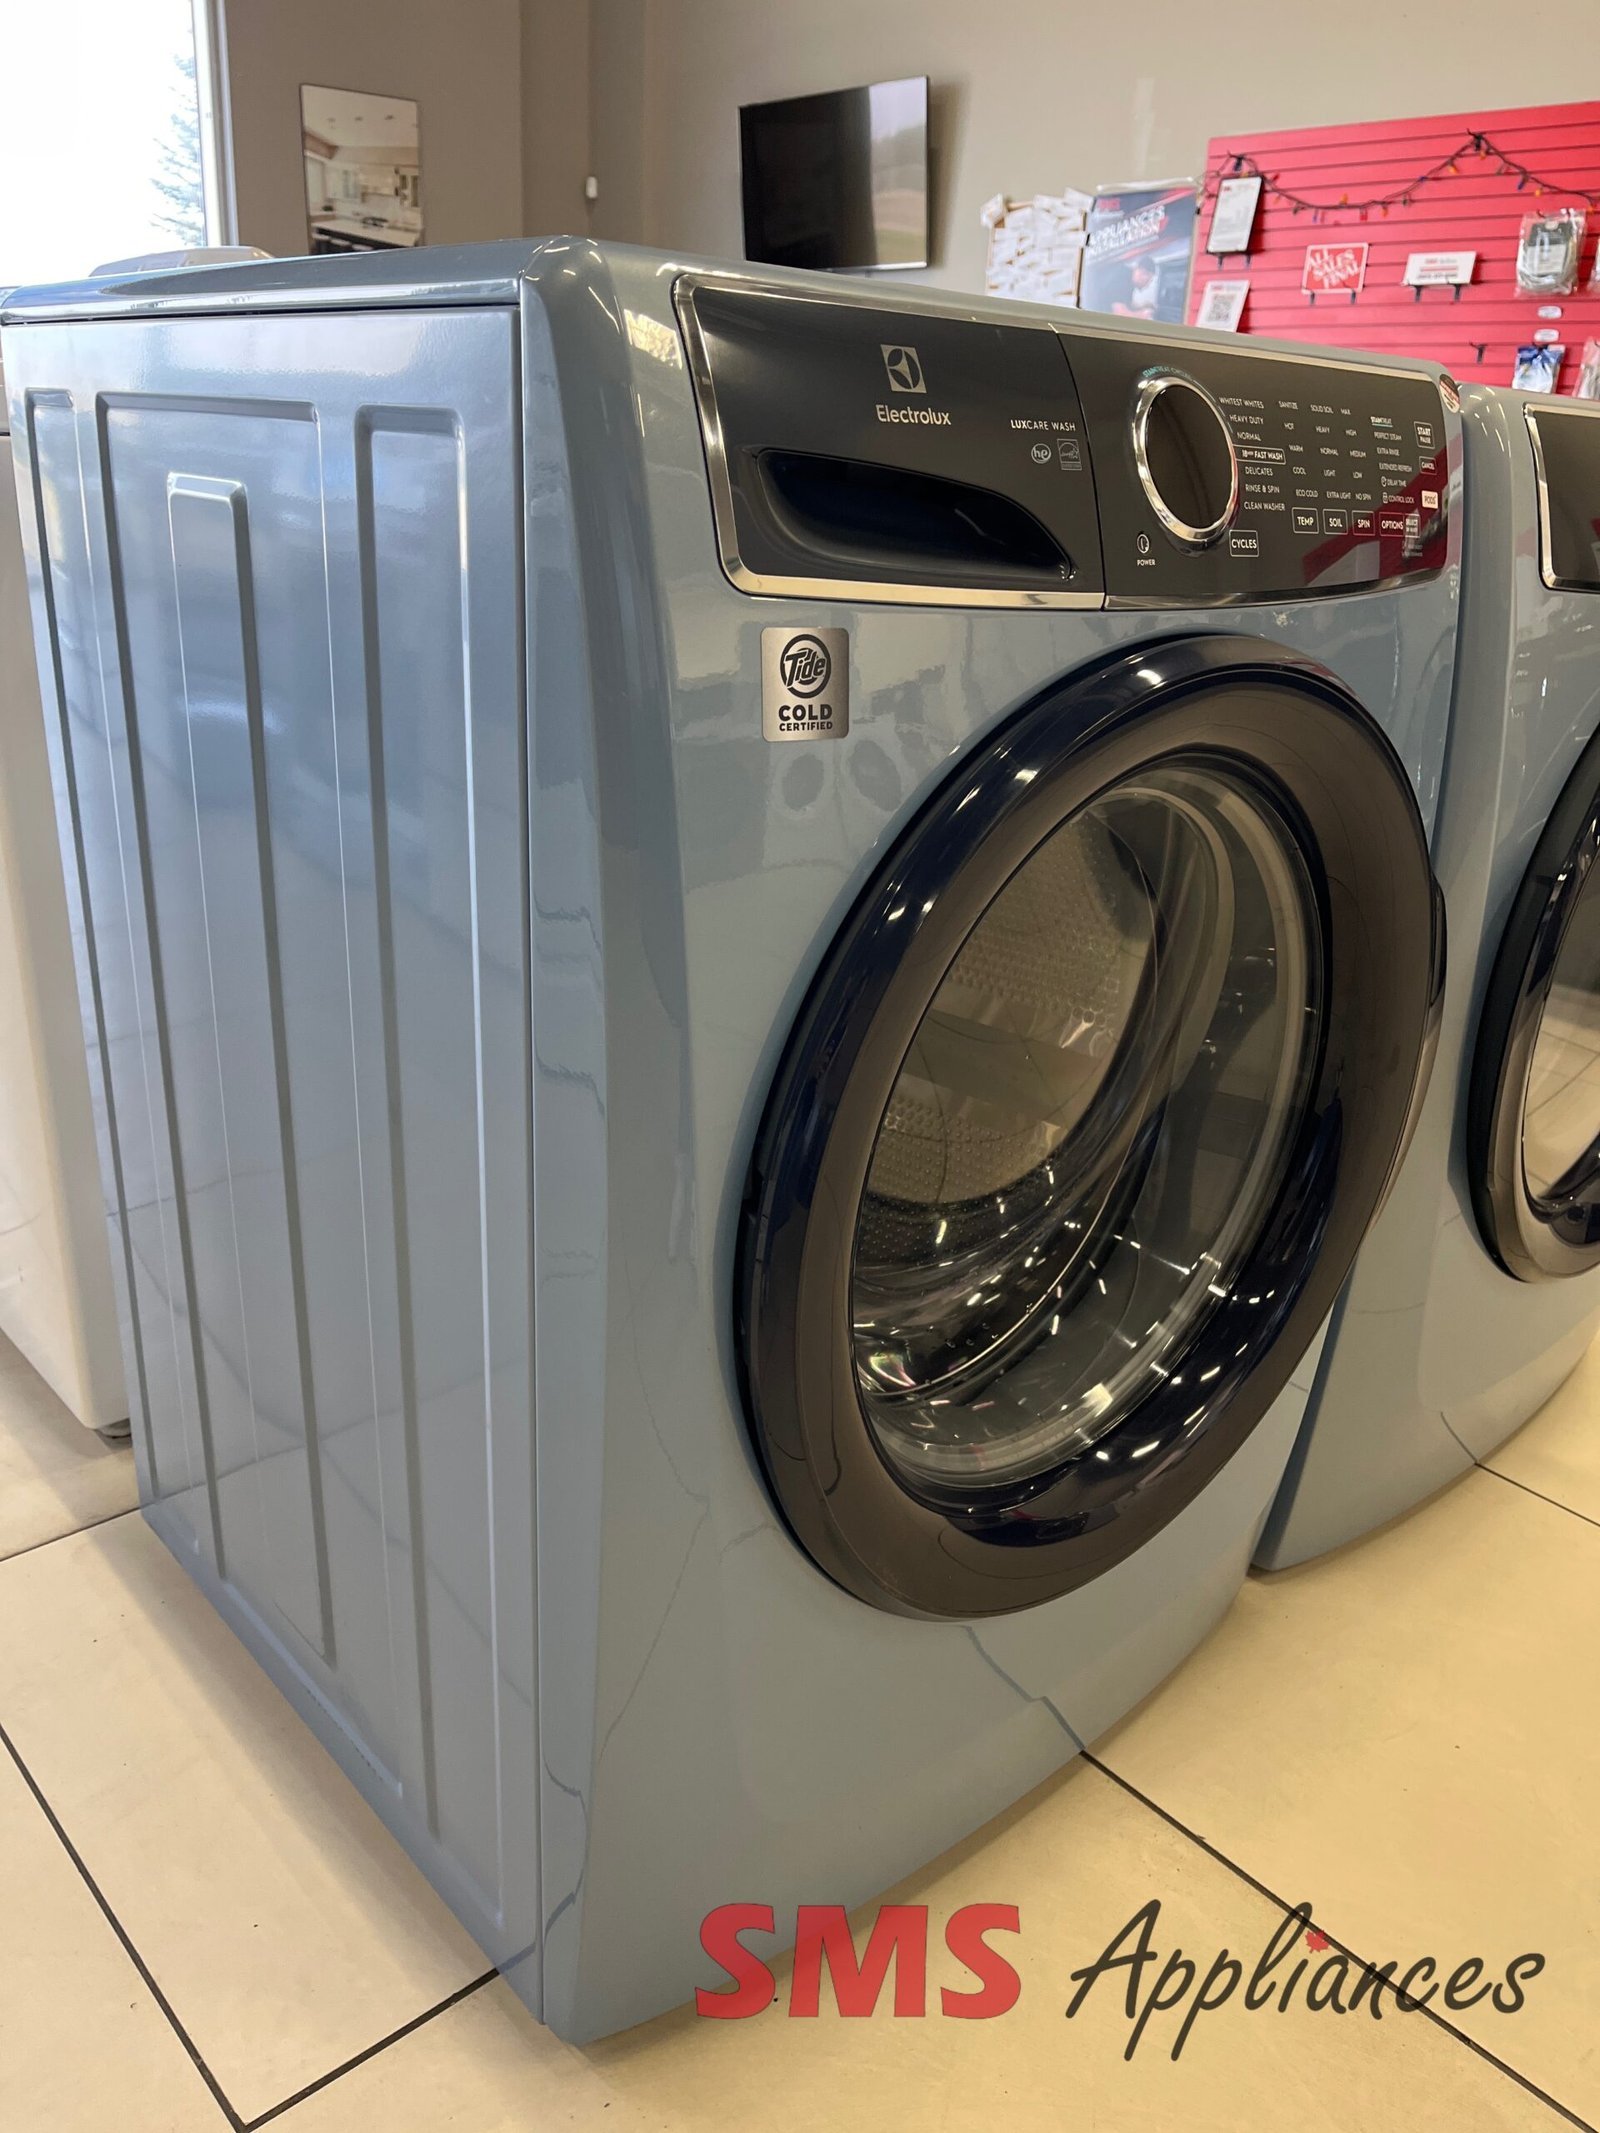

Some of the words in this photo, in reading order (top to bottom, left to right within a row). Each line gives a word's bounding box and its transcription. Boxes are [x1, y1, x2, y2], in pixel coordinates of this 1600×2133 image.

[1219, 397, 1242, 406] WHITEST
[1244, 400, 1264, 408] WHITES
[876, 404, 952, 426] Electrolux
[1230, 414, 1248, 423] HEAVY
[1248, 416, 1264, 424] DUTY
[1010, 420, 1048, 430] LUXCARE
[1051, 422, 1076, 432] WASH
[1417, 426, 1431, 436] START
[1237, 432, 1262, 441] NORMAL
[1255, 450, 1266, 459] FAST
[1267, 452, 1283, 460] WASH
[1320, 447, 1339, 456] NORMAL
[1245, 466, 1273, 476] DELICATES
[1245, 484, 1261, 493] RINSE
[1268, 485, 1280, 494] SPIN
[1244, 502, 1262, 510] CLEAN
[1264, 503, 1285, 511] WASHER
[1297, 516, 1314, 526] TEMP
[1329, 518, 1342, 527] SOIL
[1358, 519, 1370, 528] SPIN
[1382, 520, 1404, 530] OPTIONS
[1232, 539, 1257, 549] CYCLES
[785, 650, 826, 688] Tide
[778, 704, 832, 721] COLD
[779, 721, 833, 732] CERTIFIED
